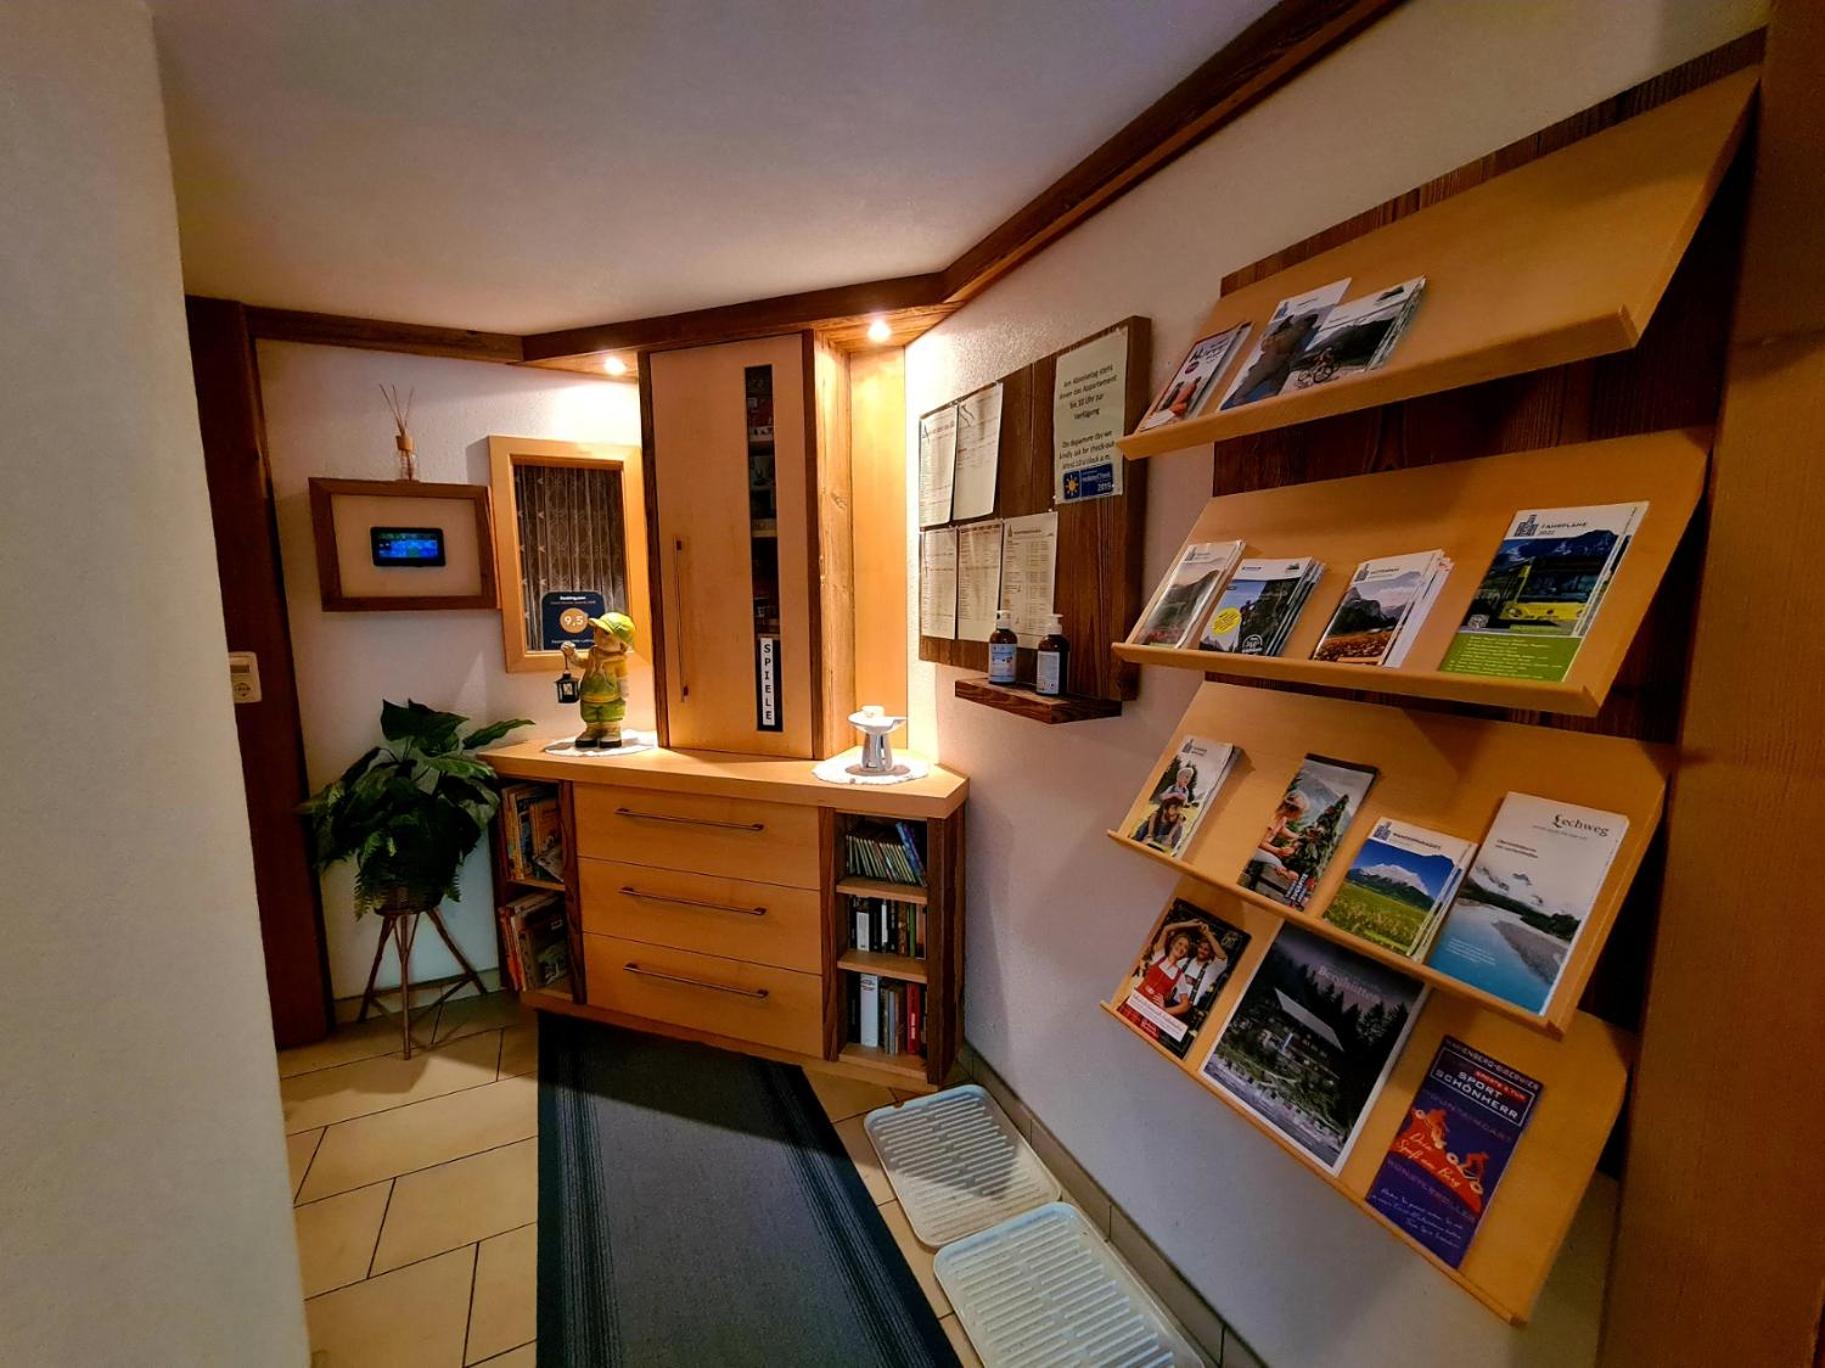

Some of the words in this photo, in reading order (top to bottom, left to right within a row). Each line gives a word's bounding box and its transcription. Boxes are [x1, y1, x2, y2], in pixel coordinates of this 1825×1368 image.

[763, 643, 772, 720] SPIELE
[1435, 1068, 1518, 1118] SCHÖNHERR
[1458, 1071, 1503, 1098] SPORT
